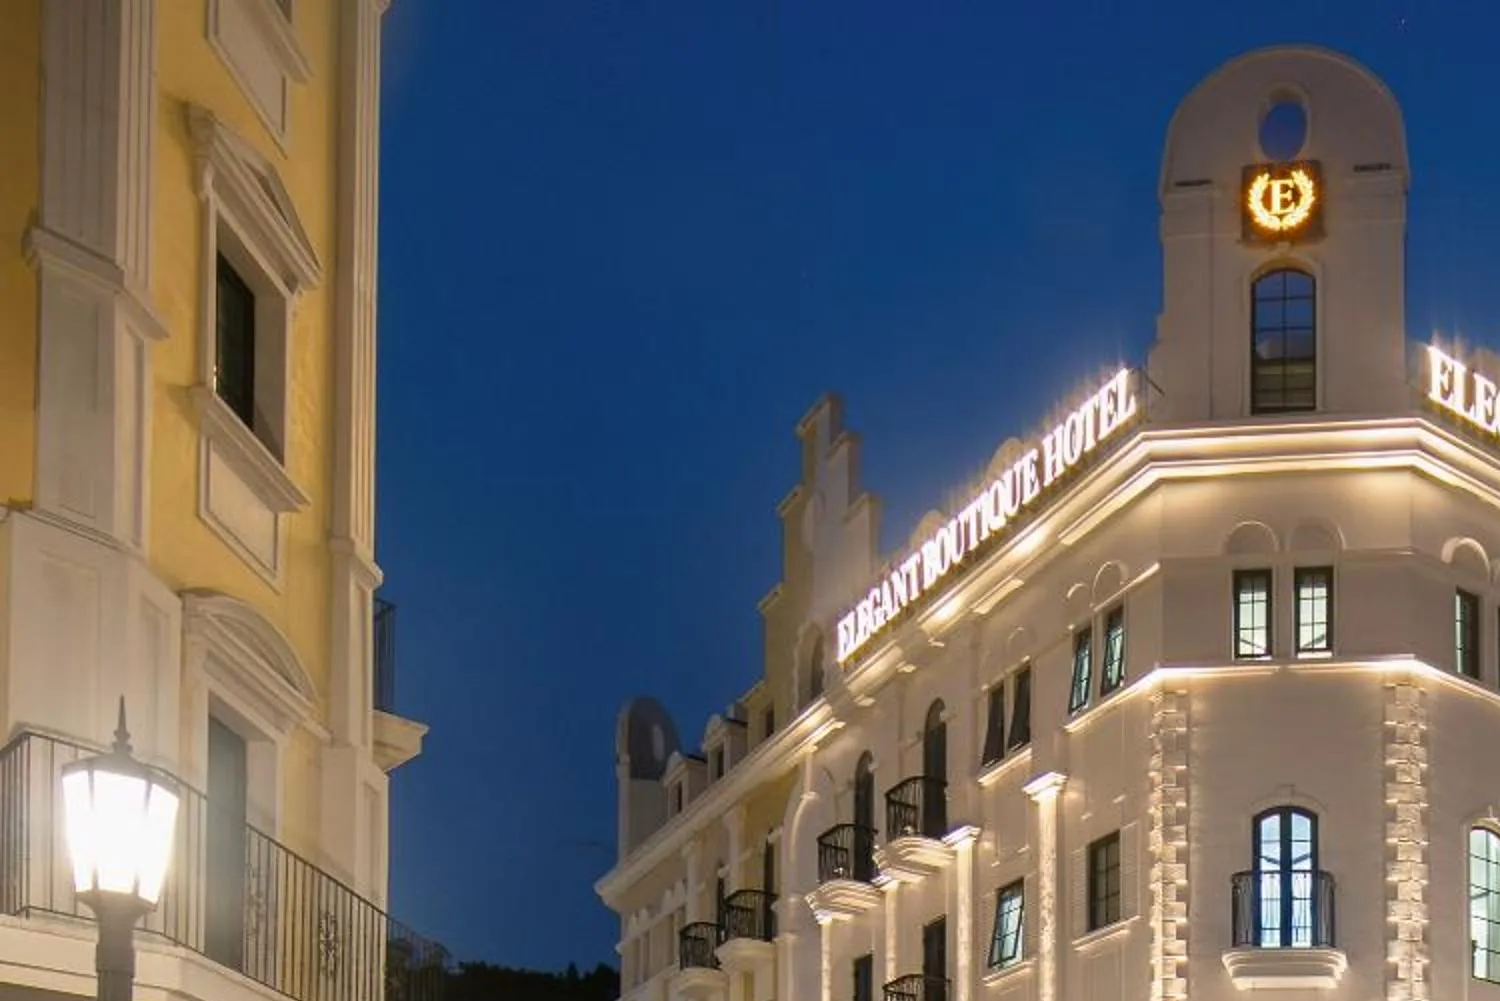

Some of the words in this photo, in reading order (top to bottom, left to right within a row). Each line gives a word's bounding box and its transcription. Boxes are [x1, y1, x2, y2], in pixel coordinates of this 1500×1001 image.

[1269, 178, 1296, 215] E
[837, 551, 921, 663] ELEGANT
[921, 447, 1040, 591] BOUTIQUE
[1041, 367, 1137, 487] HOTEL
